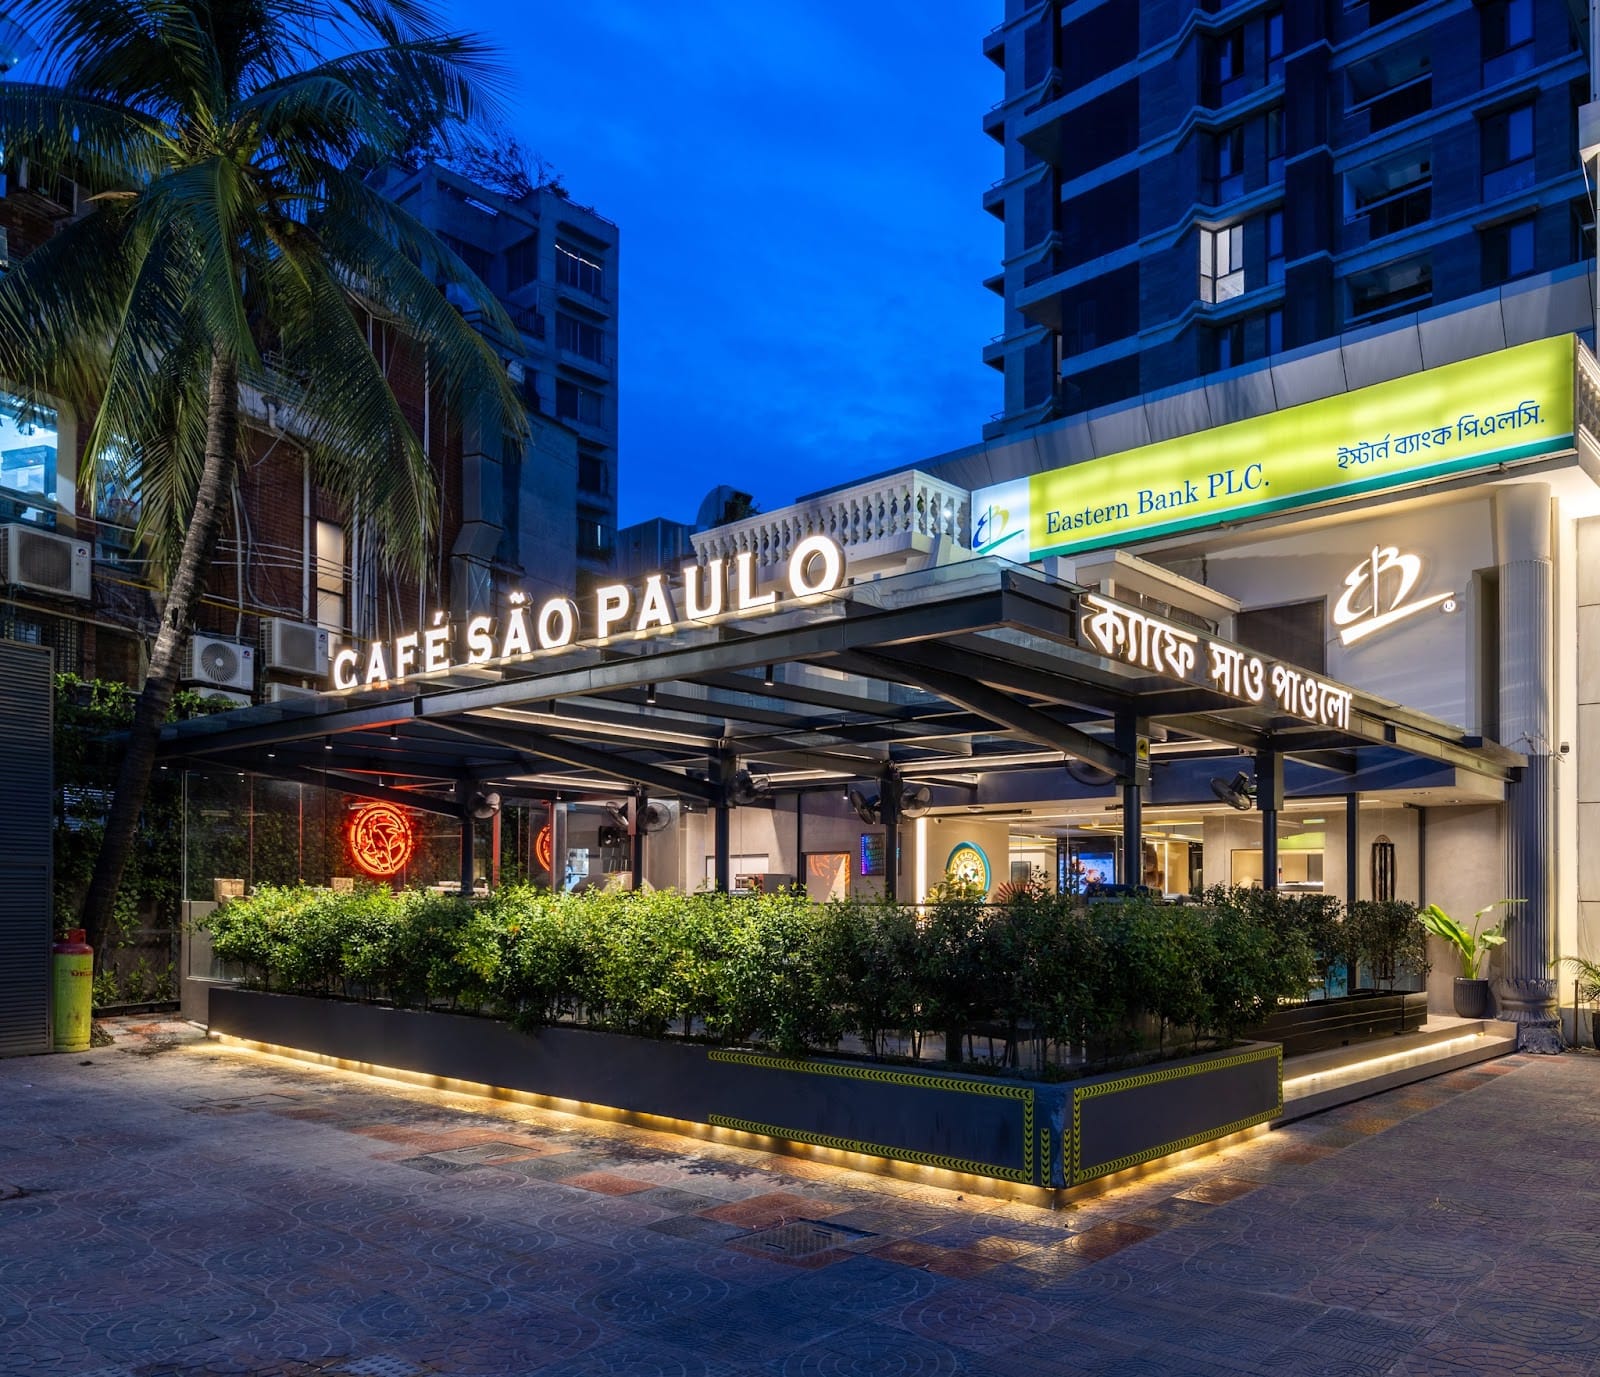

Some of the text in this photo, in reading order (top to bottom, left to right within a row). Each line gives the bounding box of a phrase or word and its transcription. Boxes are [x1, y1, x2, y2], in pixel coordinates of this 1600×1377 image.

[1337, 400, 1545, 469] ইস্টার্ন ব্যাংক পিএলসি.
[1046, 463, 1270, 534] Eastern Bank PLC.
[333, 535, 846, 691] CAFÉ SÃO PAULO
[1087, 594, 1353, 730] ক্যাফে সাও পাওলো
